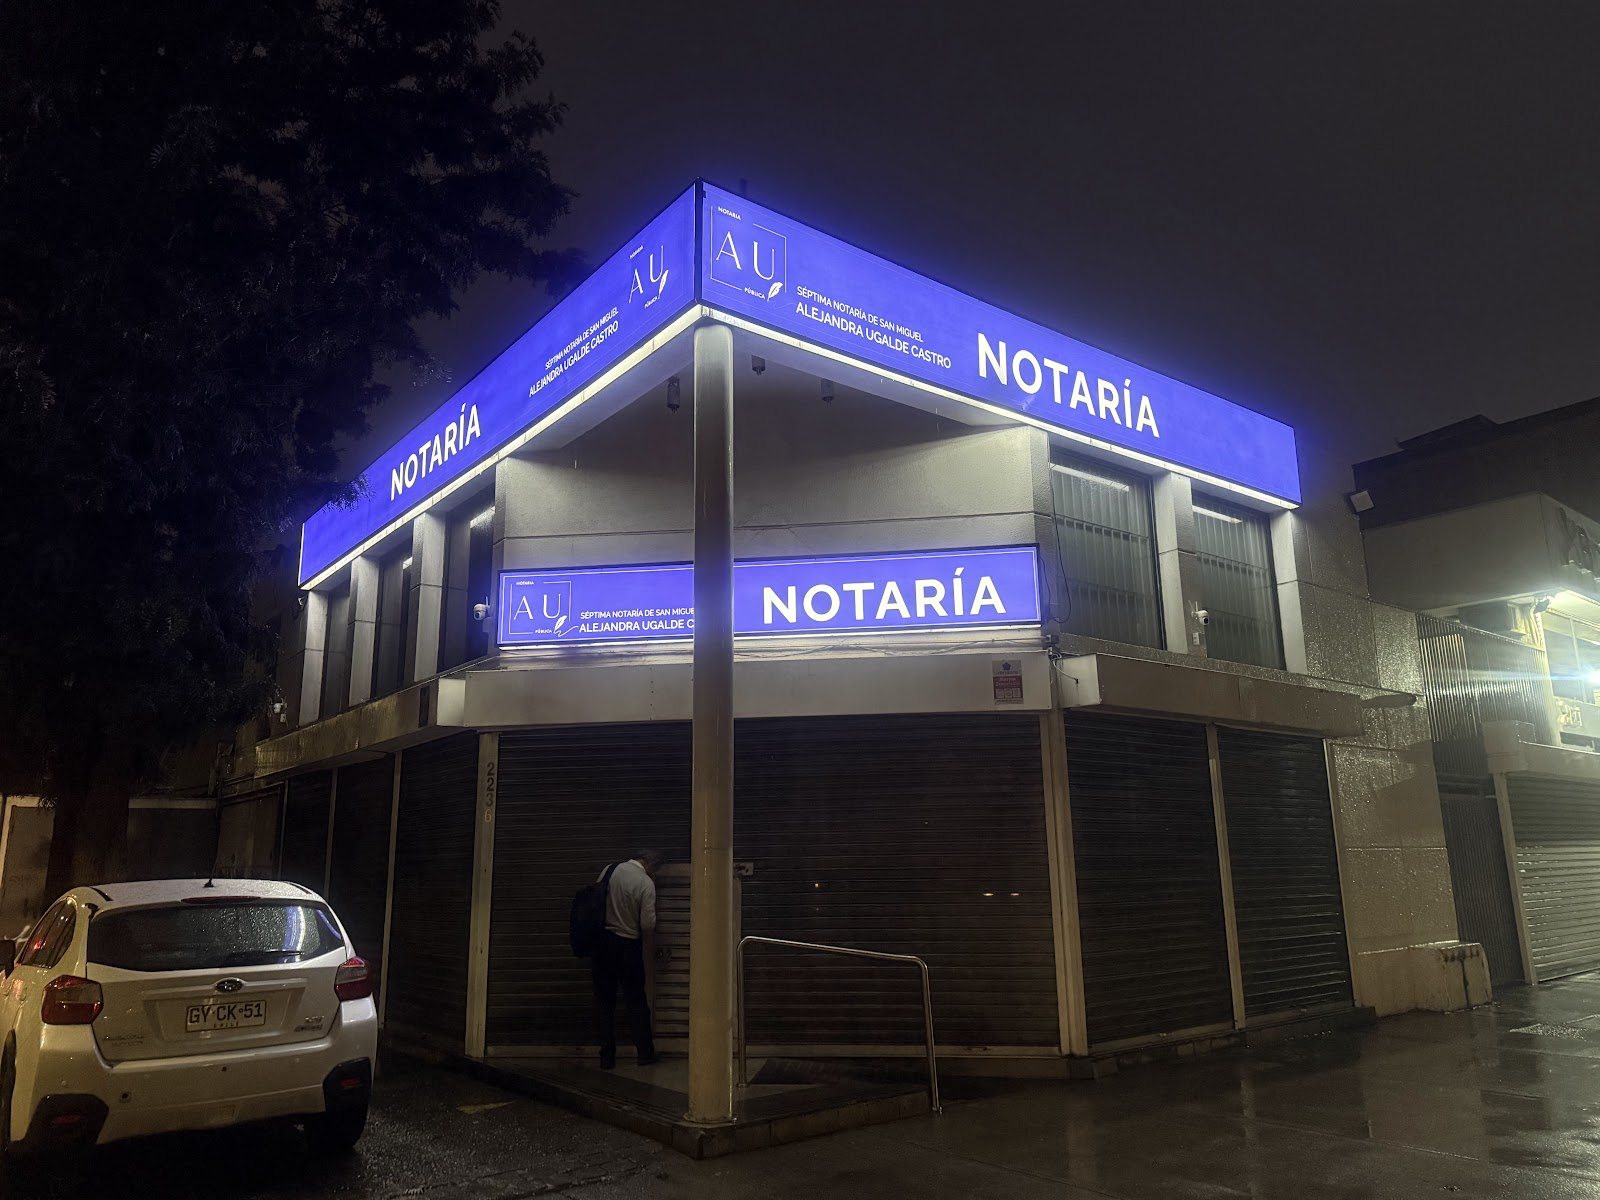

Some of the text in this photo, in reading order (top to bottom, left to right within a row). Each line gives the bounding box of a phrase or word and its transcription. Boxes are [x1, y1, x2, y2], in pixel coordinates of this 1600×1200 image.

[545, 351, 563, 370] SÉPTIMA
[583, 329, 589, 340] DE
[589, 321, 599, 335] SAN
[600, 307, 618, 326] MIGUEL
[796, 302, 951, 368] ALEJANDRA UGALDE CASTRO
[797, 286, 924, 342] SÉPTIMA NOTARÍA DE SAN MIGUEL
[529, 320, 618, 397] ALEJANDRA UGALDE CASTRO
[978, 333, 1160, 438] NOTARÍA
[391, 403, 480, 501] NOTARÍA
[579, 621, 640, 633] ALEJANDRA
[642, 619, 684, 630] UGALDE
[580, 610, 611, 619] SÉPTIMA
[612, 608, 643, 618] NOTARÍA
[763, 567, 1006, 624] NOTARÍA
[484, 762, 495, 823] 2236
